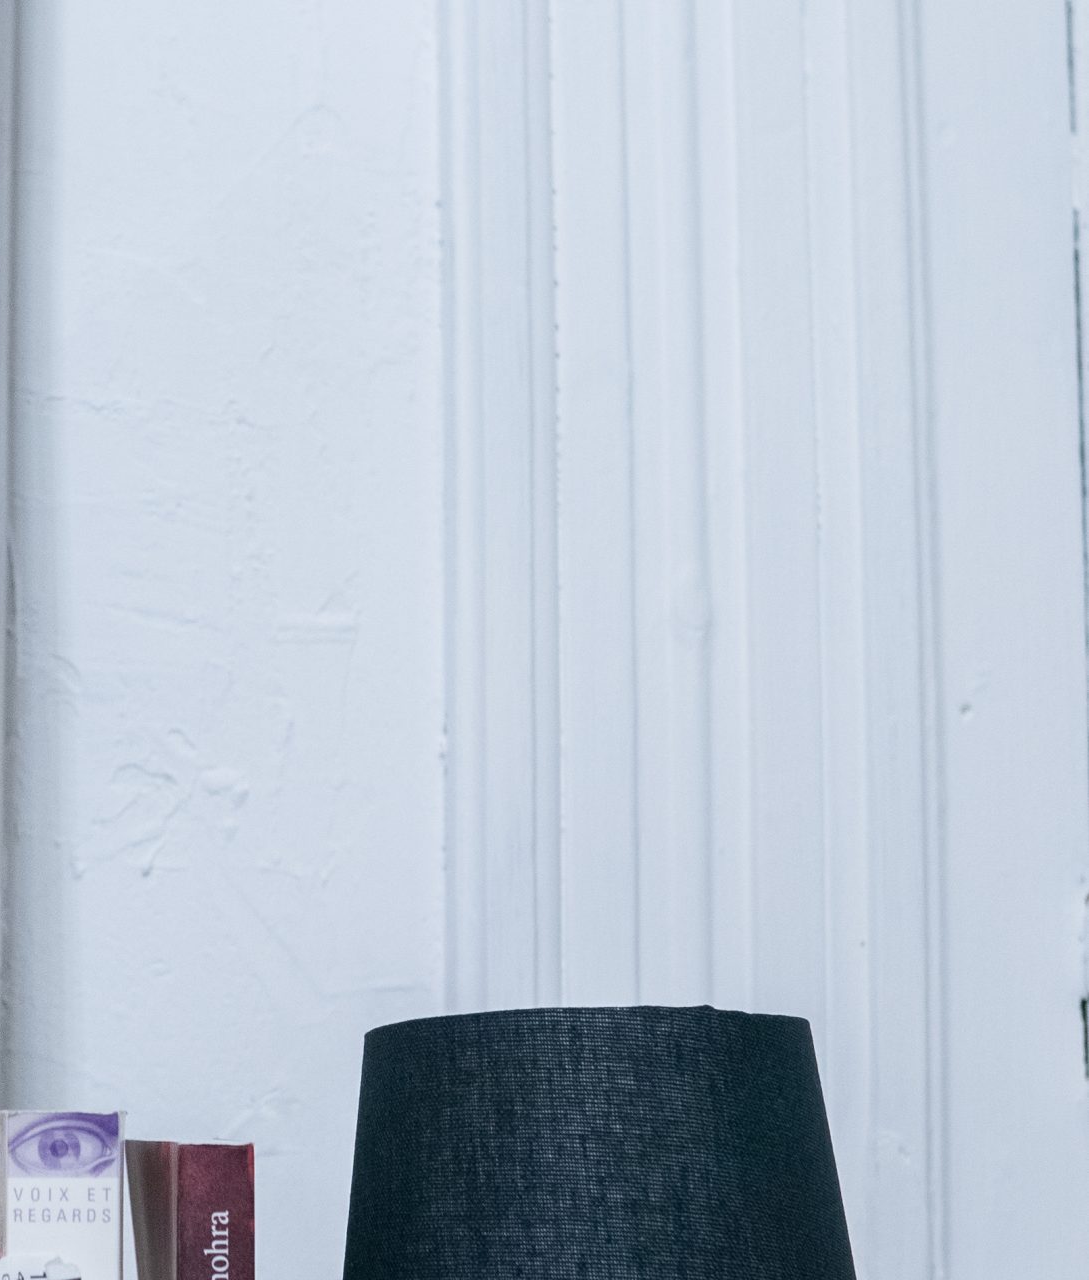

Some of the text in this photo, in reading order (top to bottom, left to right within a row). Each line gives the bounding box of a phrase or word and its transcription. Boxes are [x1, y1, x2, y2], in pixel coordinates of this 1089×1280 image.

[13, 1187, 112, 1202] VOIX ET
[13, 1208, 112, 1223] REGARDS
